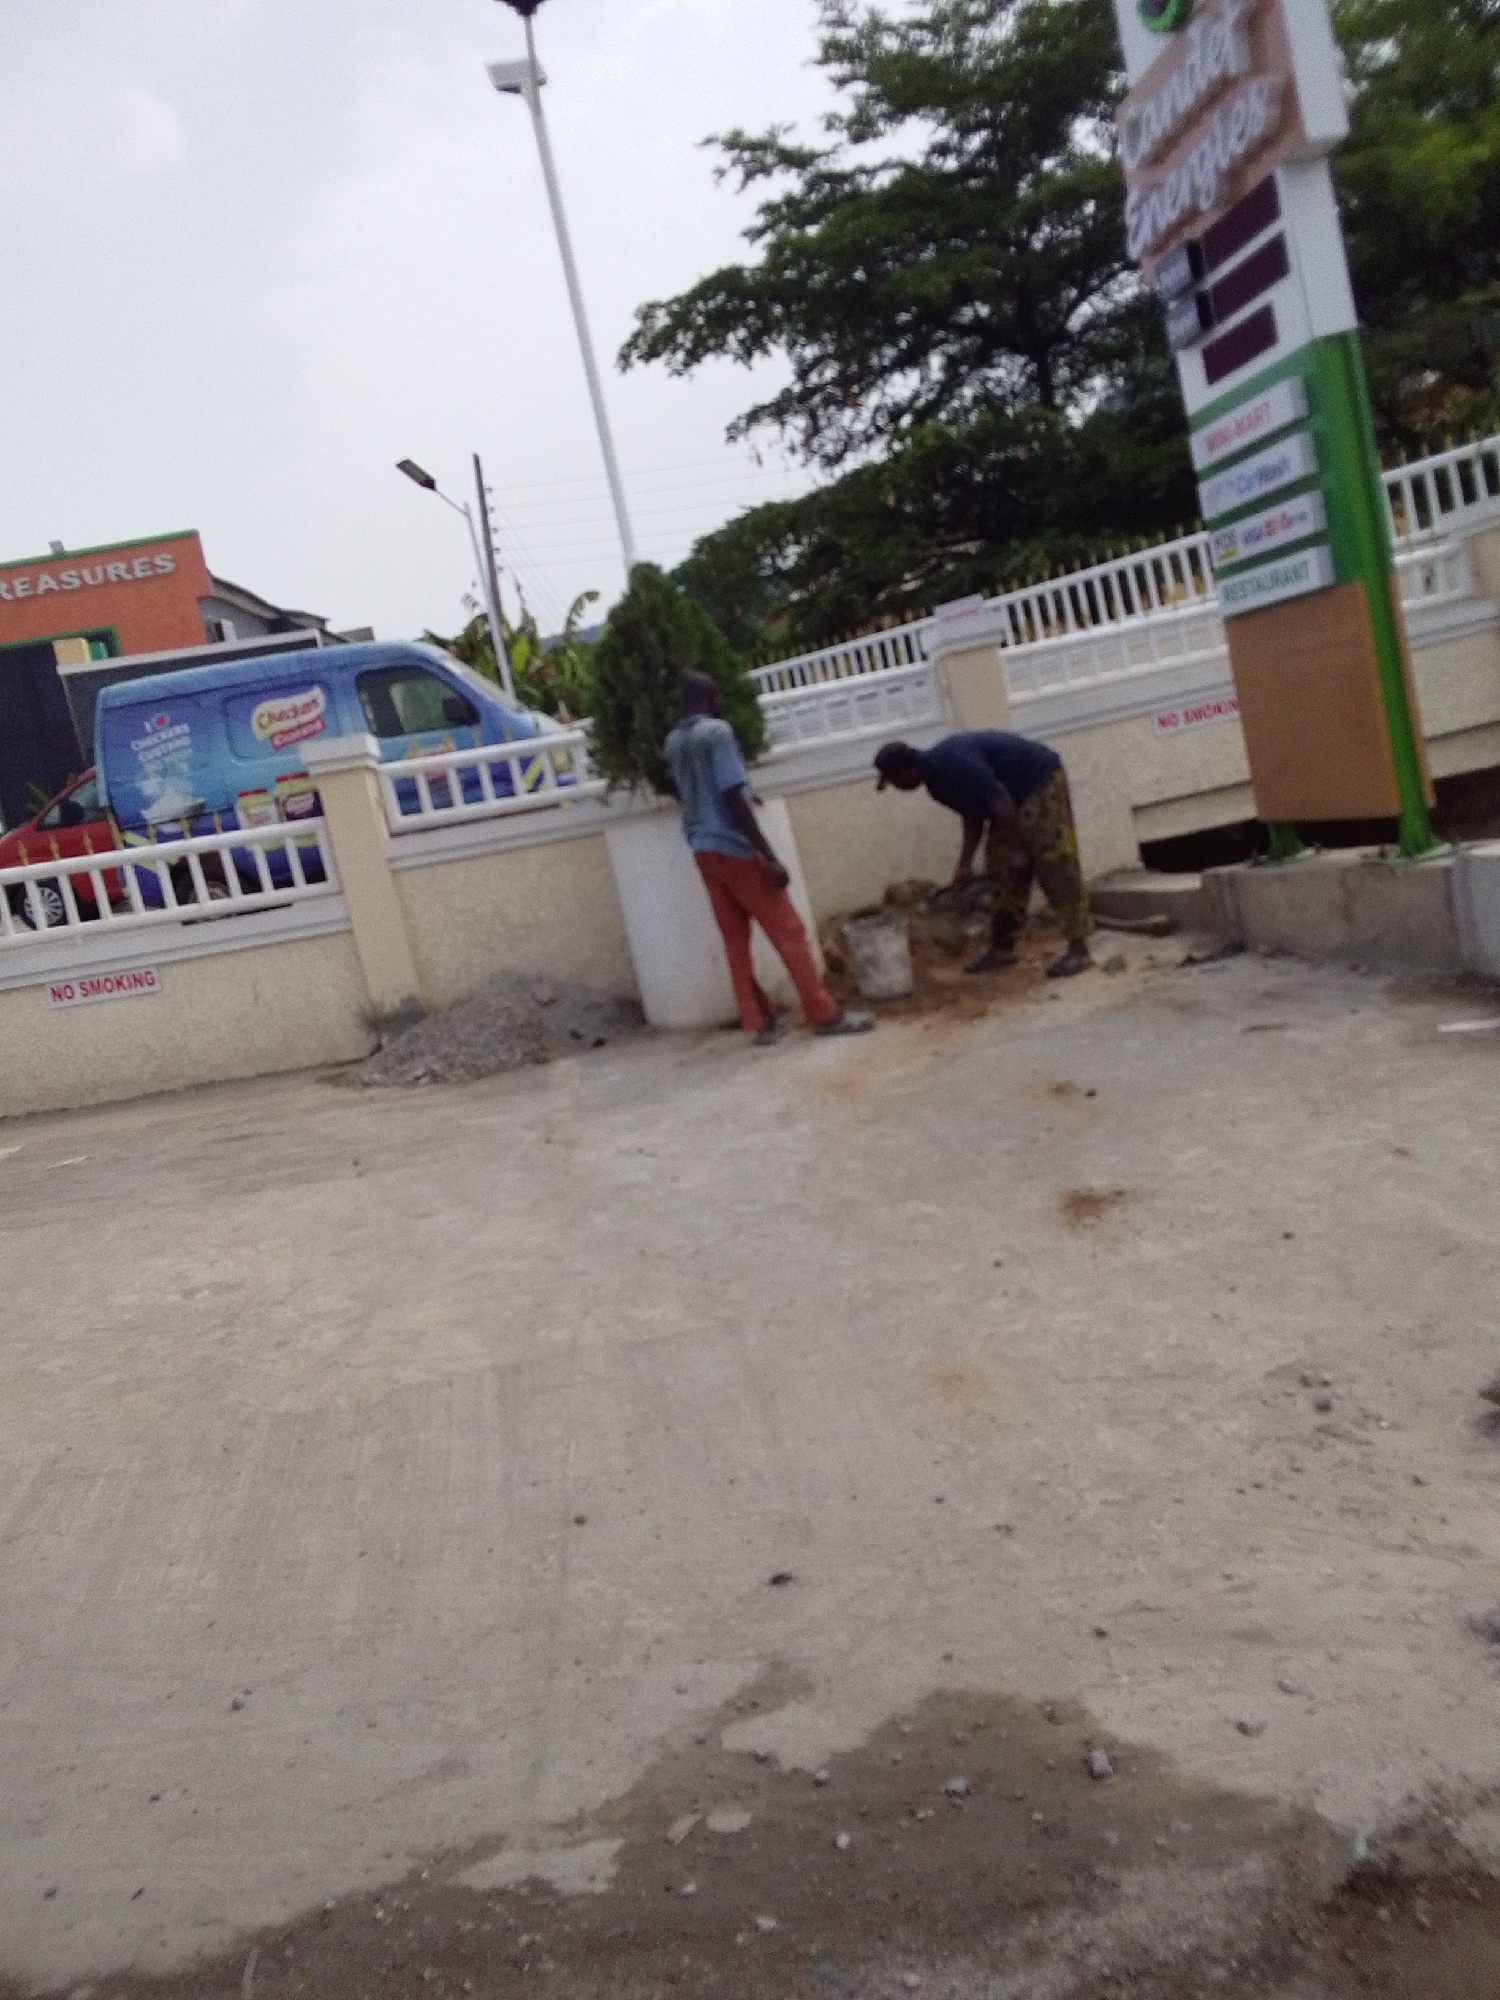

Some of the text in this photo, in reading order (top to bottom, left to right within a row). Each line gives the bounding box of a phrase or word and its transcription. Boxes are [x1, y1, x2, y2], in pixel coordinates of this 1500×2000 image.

[1221, 560, 1310, 602] RESTAURANT
[50, 970, 156, 1002] NO SMOKING
